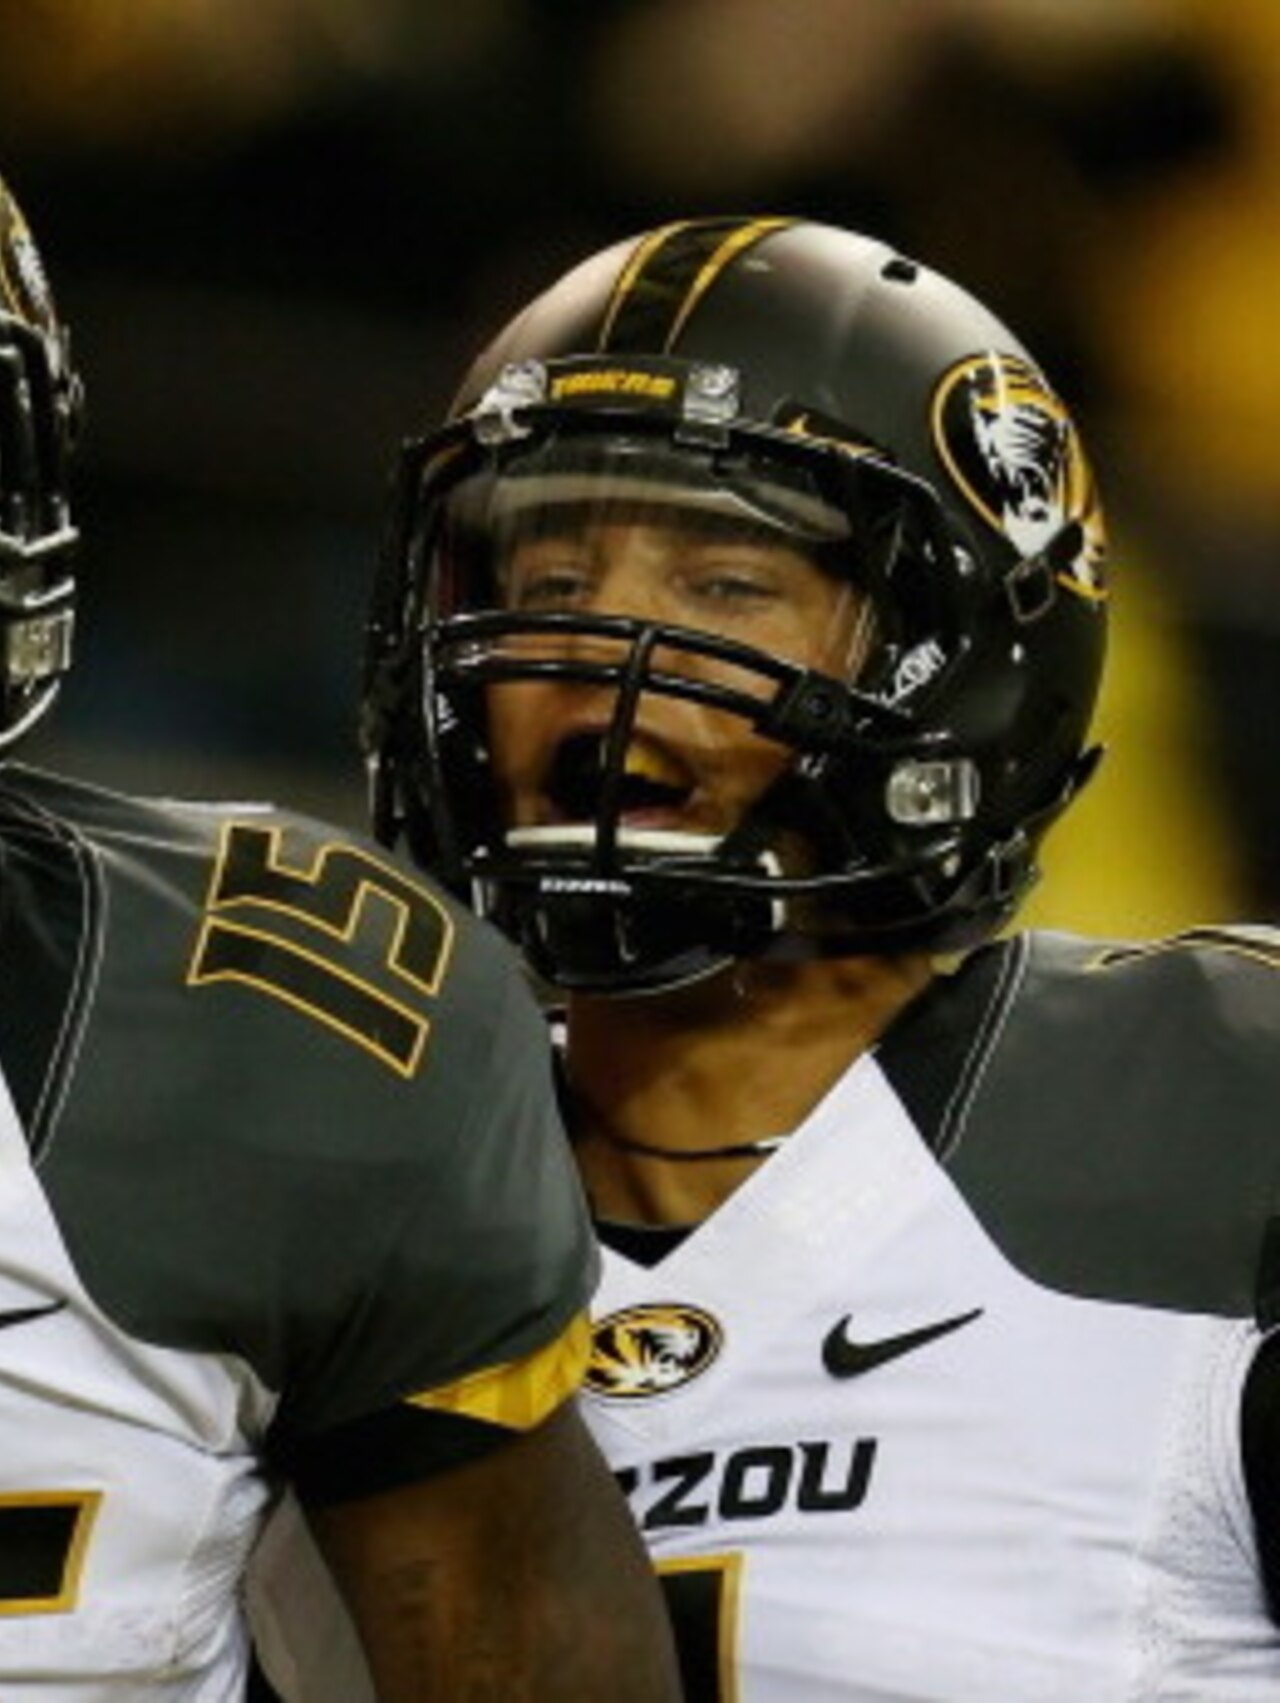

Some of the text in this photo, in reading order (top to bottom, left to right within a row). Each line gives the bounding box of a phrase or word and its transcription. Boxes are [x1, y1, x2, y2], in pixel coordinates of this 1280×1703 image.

[550, 368, 675, 400] TIGERS
[188, 820, 454, 1077] 15
[614, 1437, 877, 1531] ZOU
